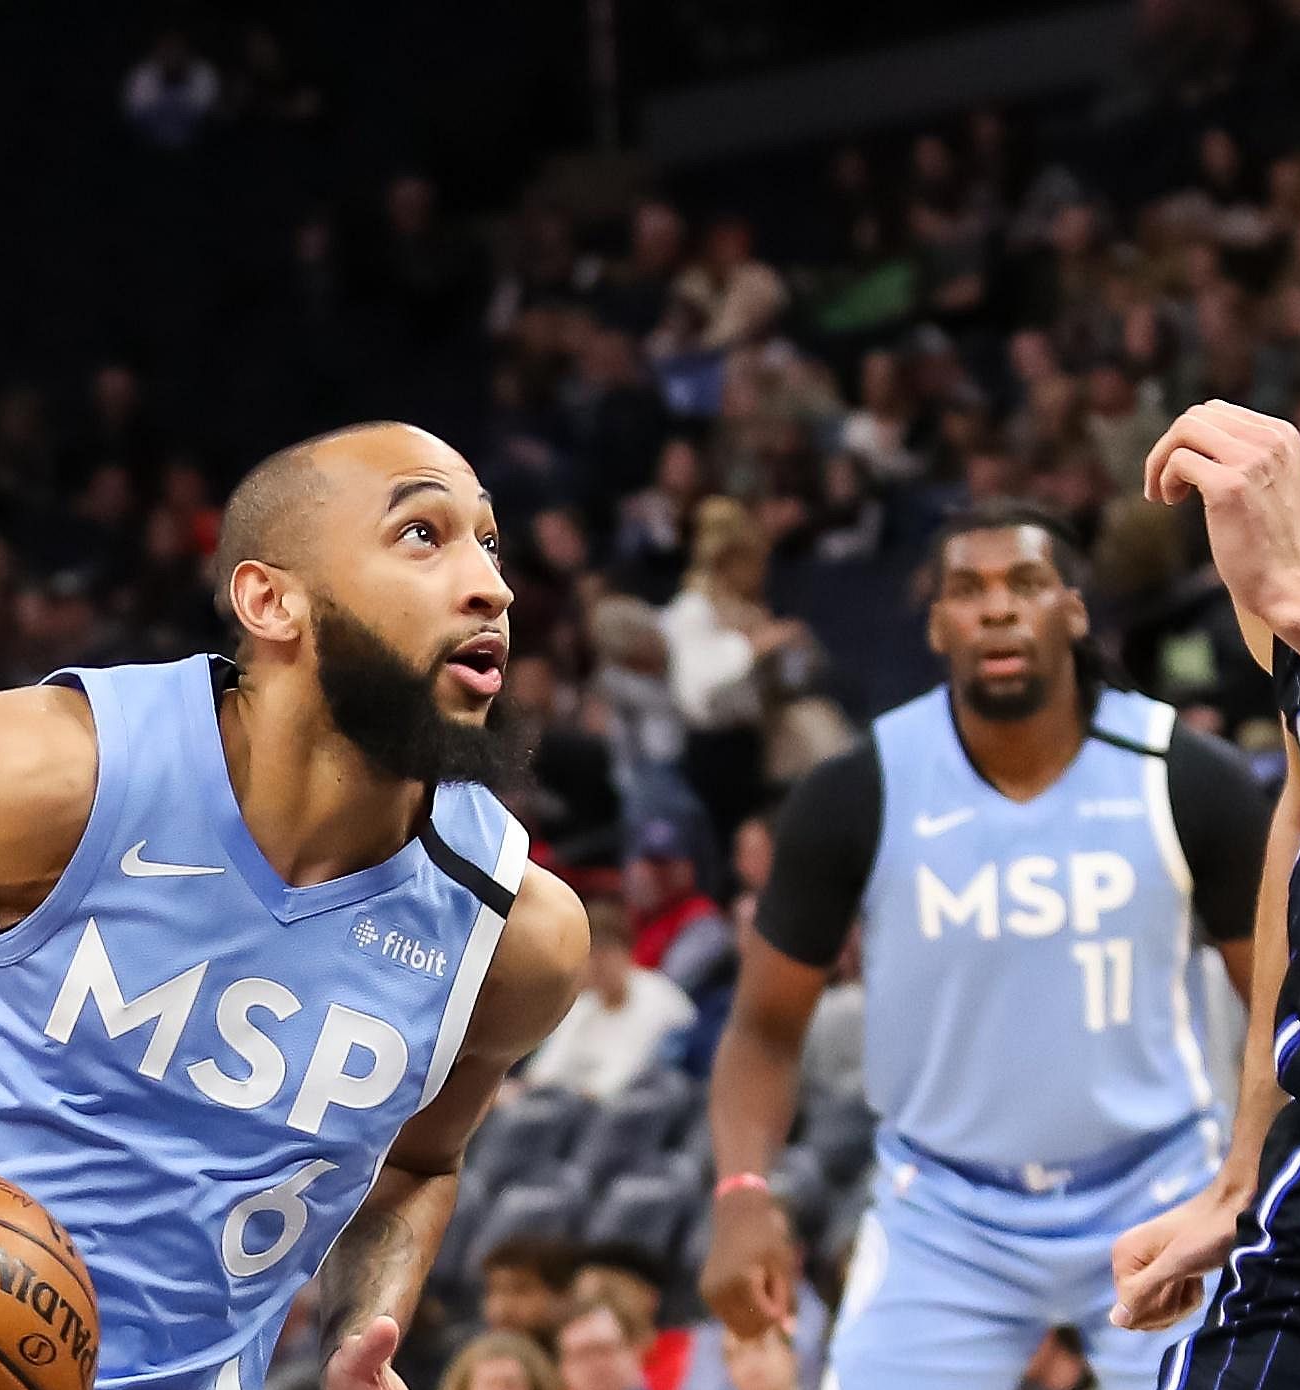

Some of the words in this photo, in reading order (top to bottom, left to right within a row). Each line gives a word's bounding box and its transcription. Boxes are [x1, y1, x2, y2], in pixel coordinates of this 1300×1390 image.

[915, 850, 1136, 941] MSP
[382, 930, 447, 977] fitbit
[1072, 938, 1133, 1033] 11
[44, 916, 409, 1135] MSP
[221, 1158, 340, 1278] 6
